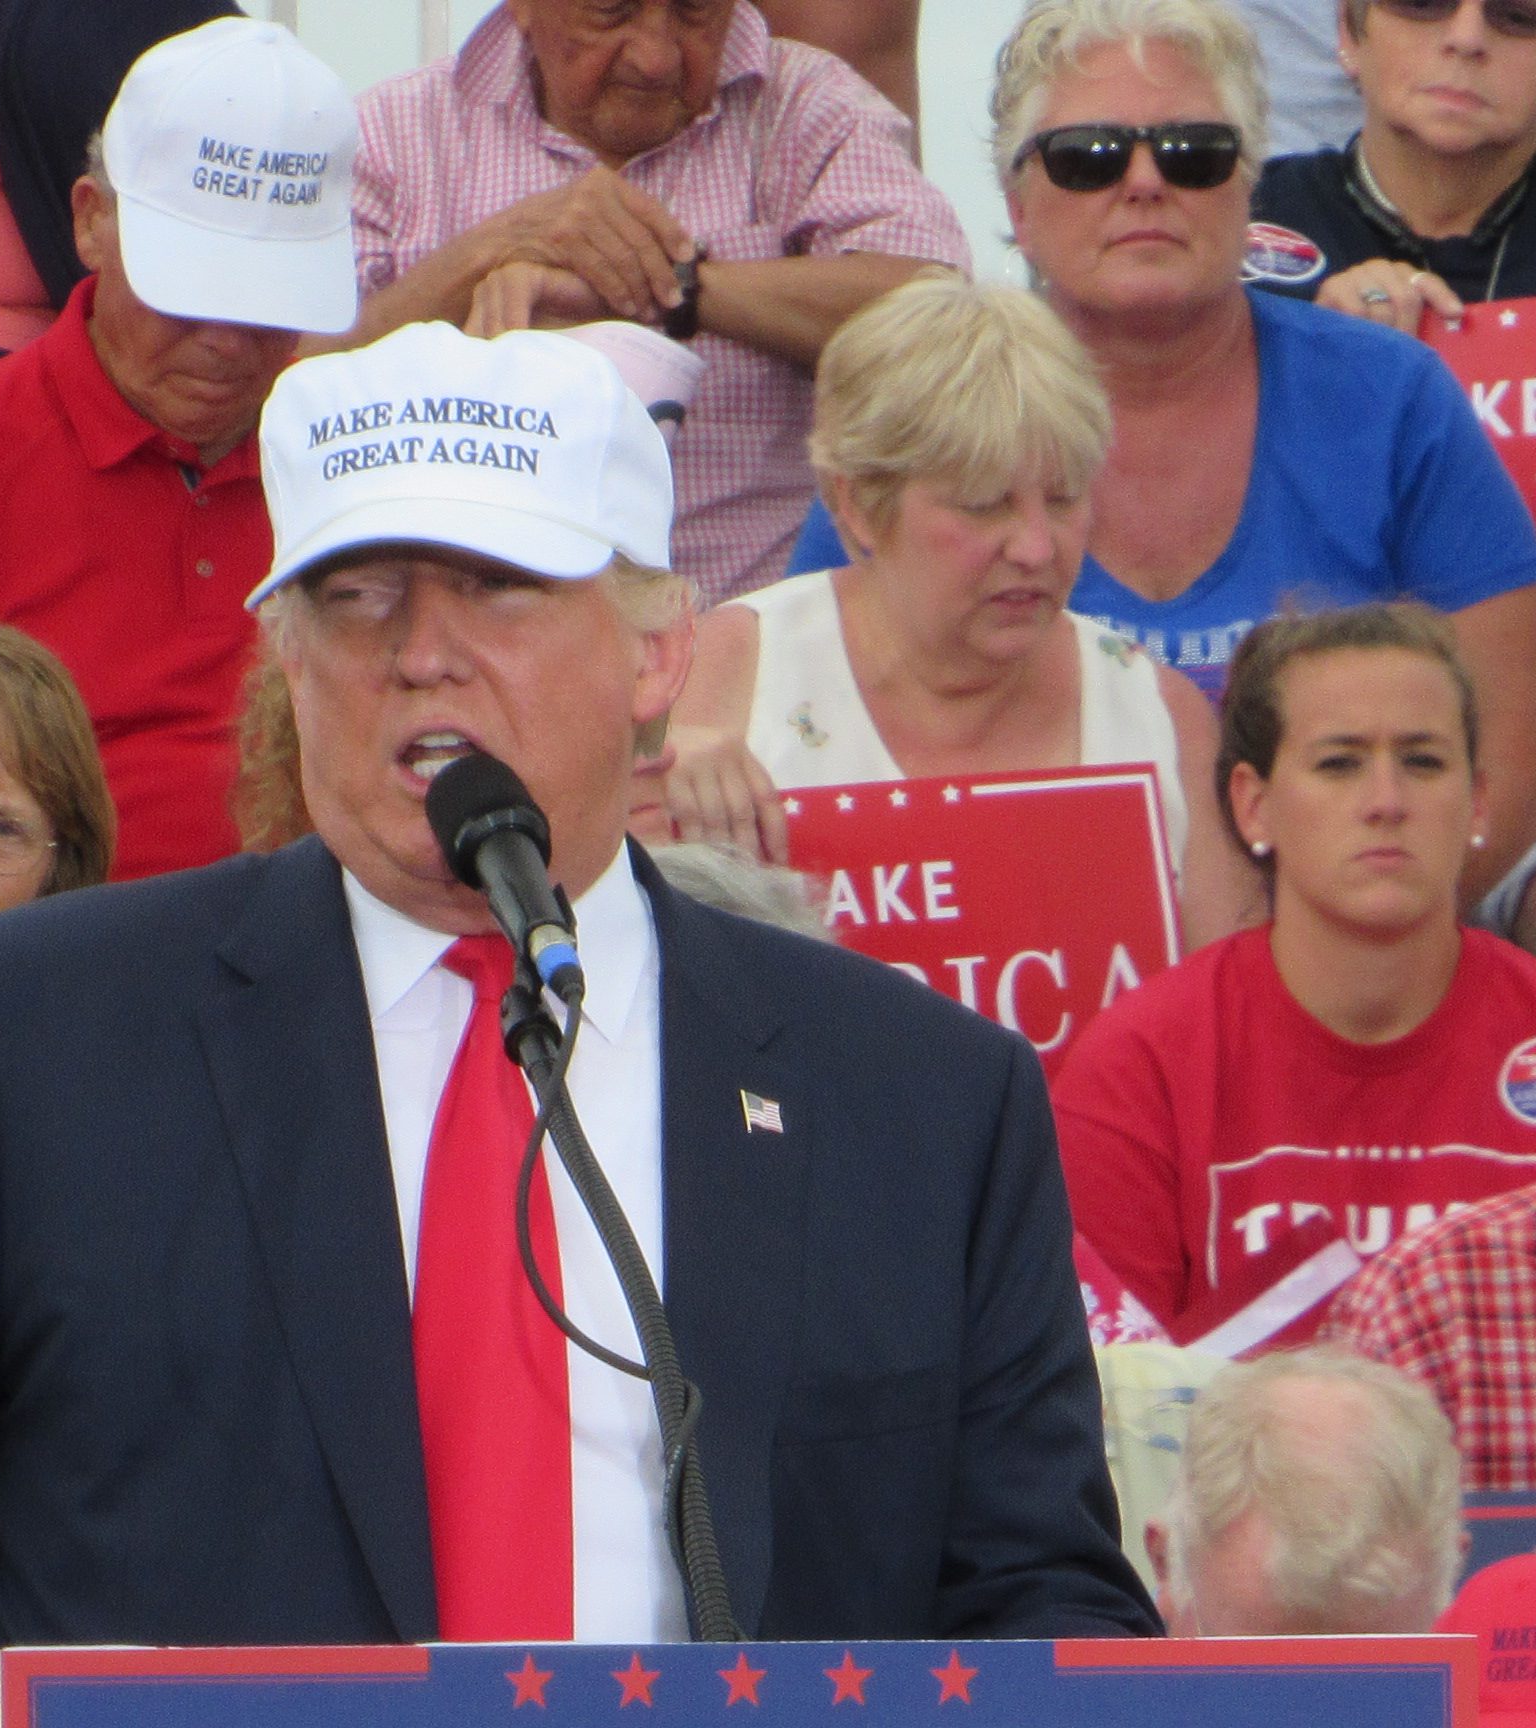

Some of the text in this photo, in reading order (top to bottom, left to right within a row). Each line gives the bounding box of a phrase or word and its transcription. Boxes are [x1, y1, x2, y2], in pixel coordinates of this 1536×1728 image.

[198, 136, 254, 170] MAKE
[192, 165, 263, 201] GREAT
[308, 397, 560, 450] MAKE AMERICA
[322, 436, 541, 483] GREAT AGAIN
